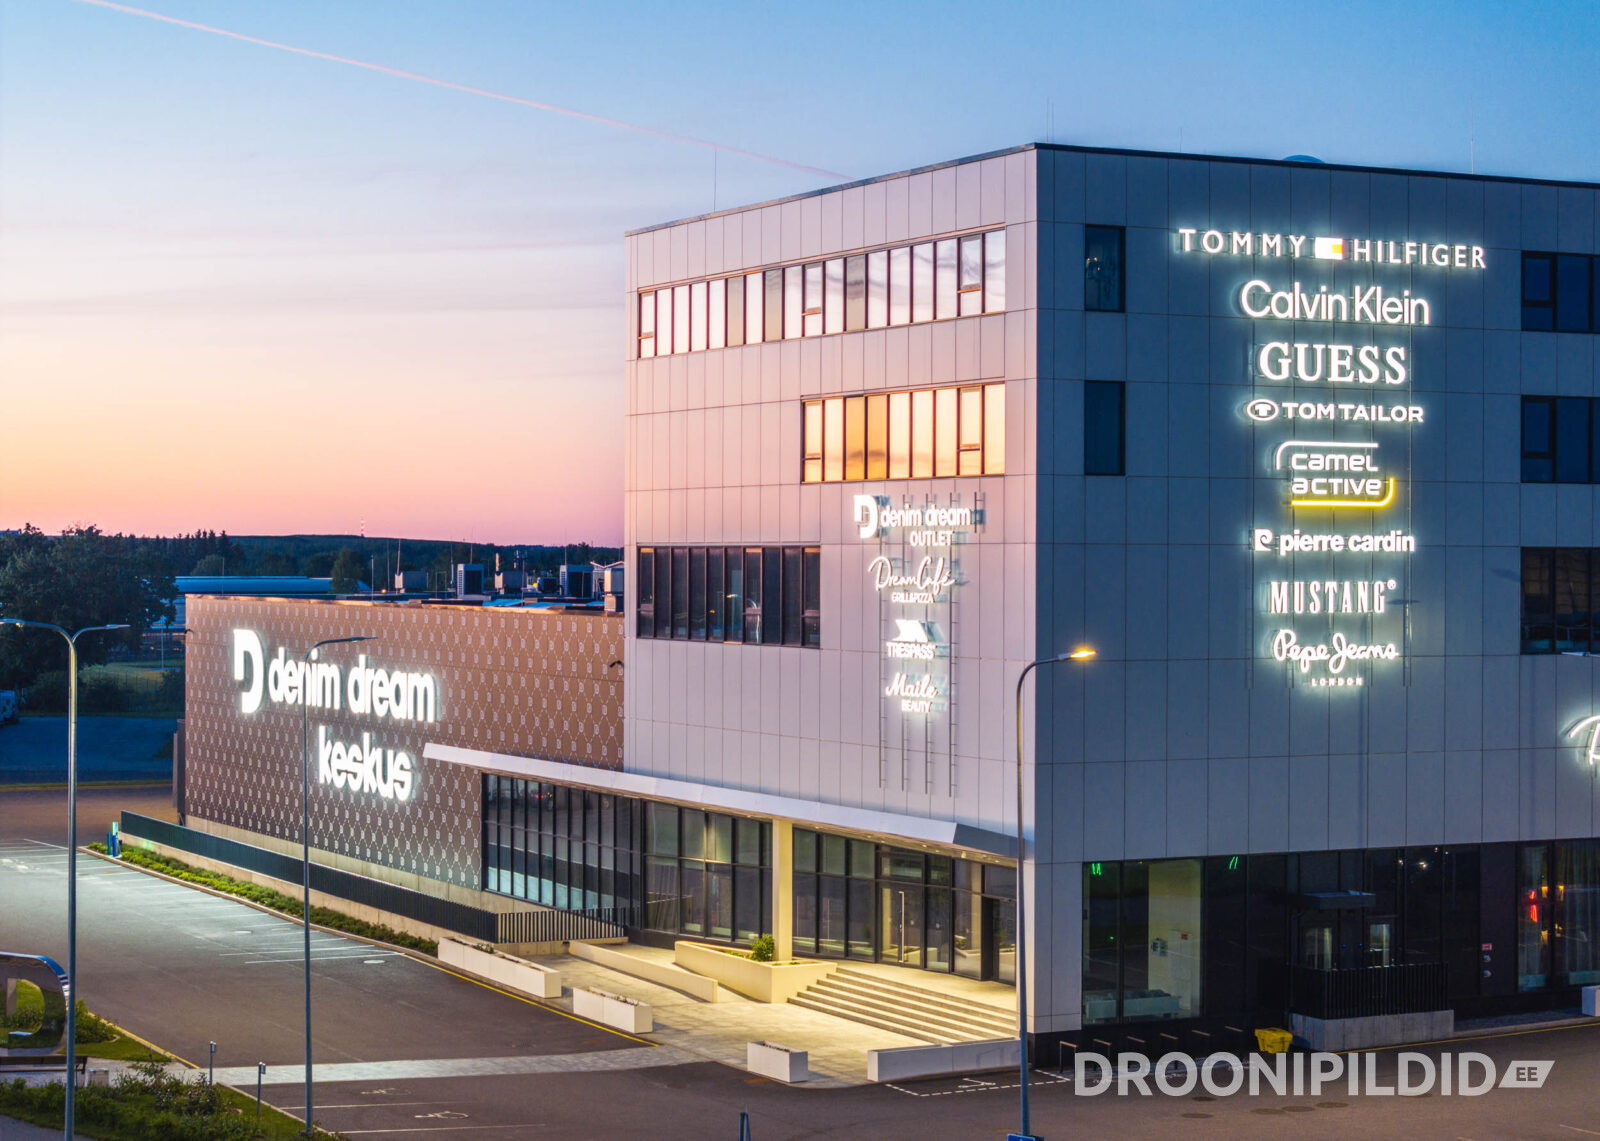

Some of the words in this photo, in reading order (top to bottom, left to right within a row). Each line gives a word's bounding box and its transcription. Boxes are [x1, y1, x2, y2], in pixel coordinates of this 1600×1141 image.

[1179, 228, 1305, 258] TOMMY
[1354, 238, 1486, 269] HILFIGER
[1241, 280, 1347, 321] Calvin
[1354, 285, 1429, 324] Klein
[1259, 341, 1406, 385] GUESS
[1282, 402, 1335, 420] TOM
[1338, 403, 1424, 422] TAILOR
[880, 503, 922, 527] denim
[924, 503, 971, 527] dream
[910, 530, 953, 547] OUTLET
[1279, 529, 1344, 557] pierre
[1348, 529, 1415, 552] cardin
[886, 641, 936, 660] TRESPASS
[1273, 629, 1331, 673] Pepe
[1328, 632, 1399, 674] Jeans
[268, 646, 341, 711] denim
[347, 653, 437, 723] dream
[1311, 677, 1363, 688] LONDON
[318, 725, 413, 802] keskus
